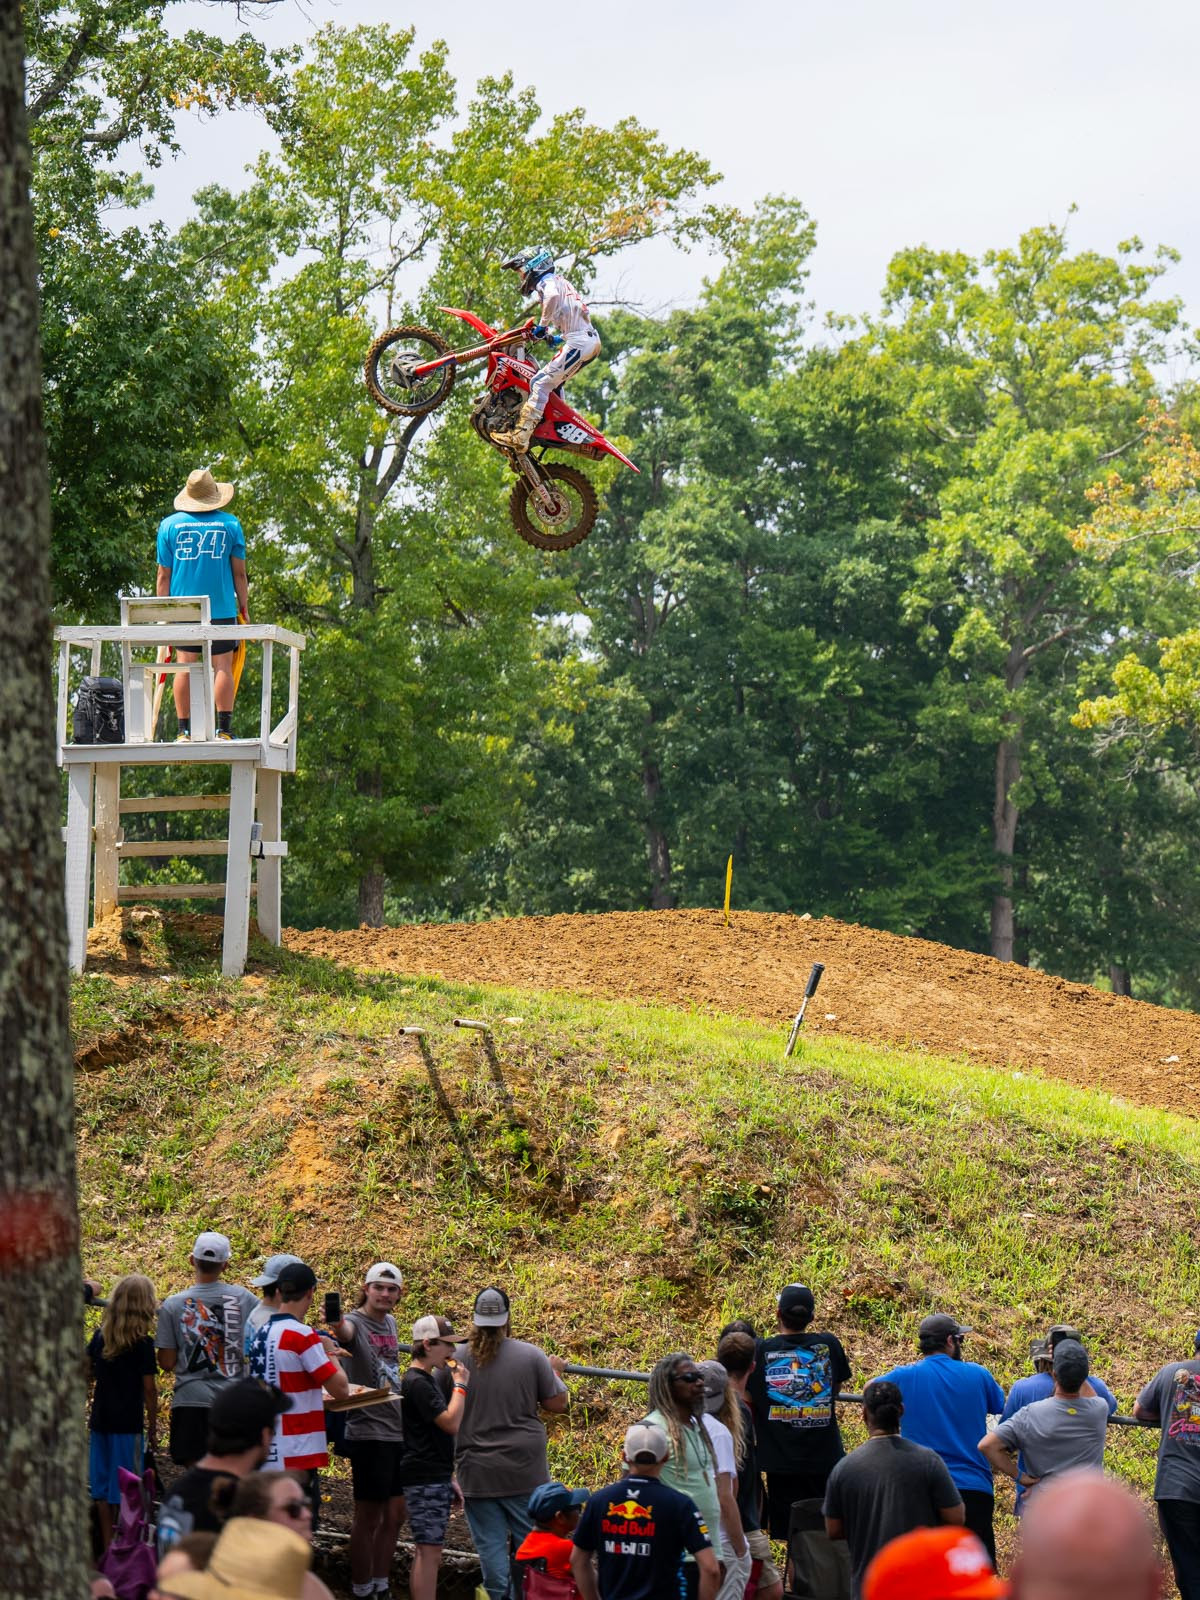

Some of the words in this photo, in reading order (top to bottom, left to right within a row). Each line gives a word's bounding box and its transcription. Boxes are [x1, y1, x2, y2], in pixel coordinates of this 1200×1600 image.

[572, 415, 595, 434] HONDA
[175, 529, 226, 560] 34
[222, 1295, 241, 1377] SEXTON
[769, 1368, 790, 1376] 2024
[602, 1519, 628, 1535] Red
[629, 1521, 655, 1537] Bull
[605, 1540, 637, 1555] Mobil
